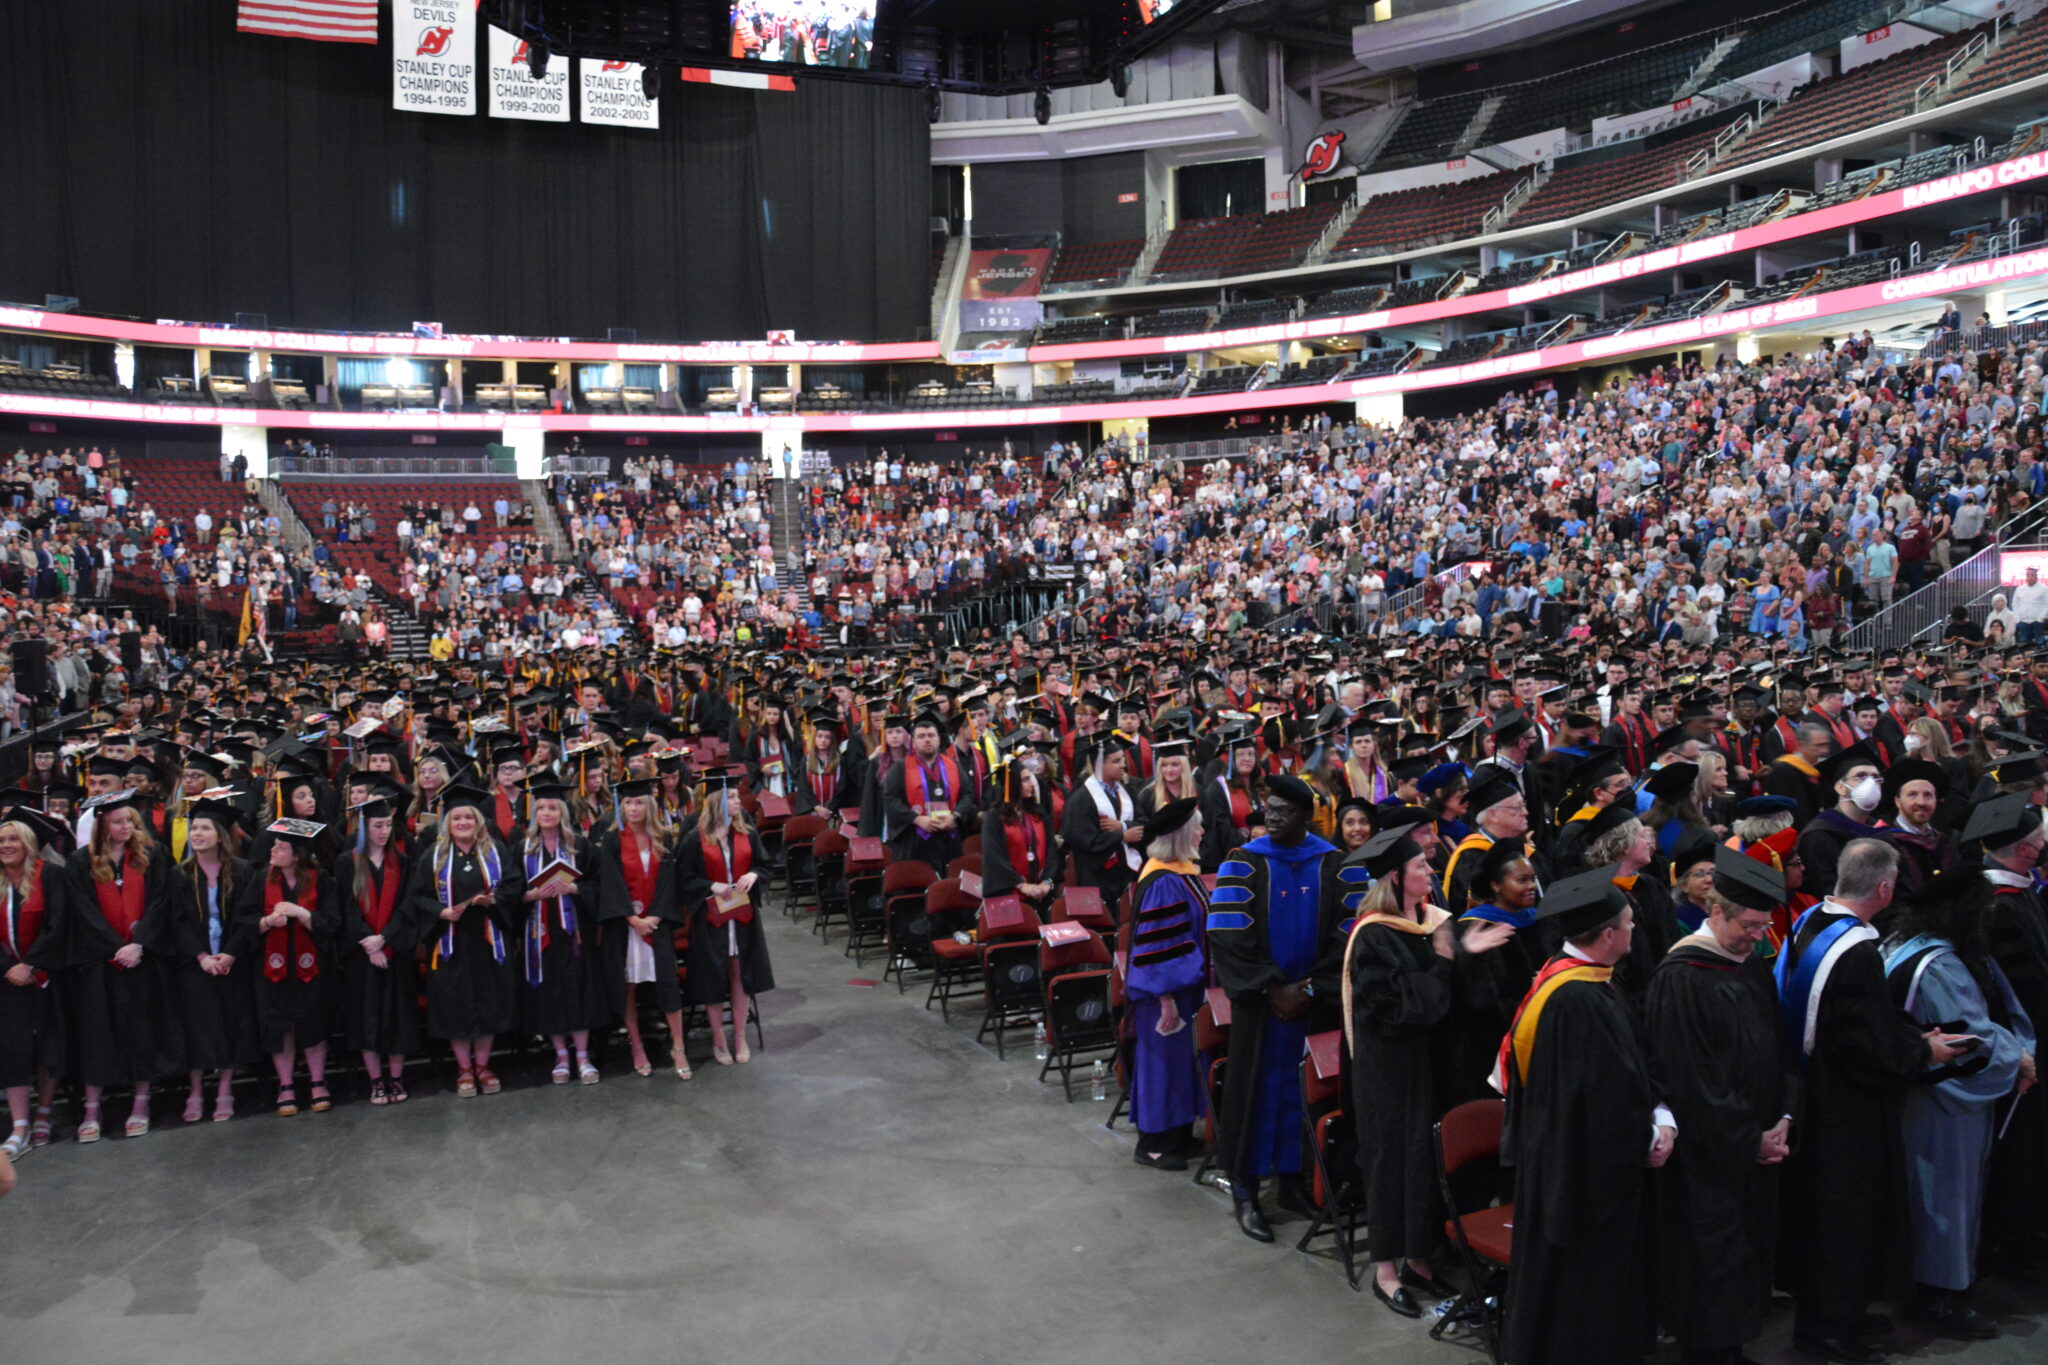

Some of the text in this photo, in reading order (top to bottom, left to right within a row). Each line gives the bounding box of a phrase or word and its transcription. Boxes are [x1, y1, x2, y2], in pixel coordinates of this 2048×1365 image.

[414, 8, 456, 23] DEVILS
[396, 59, 472, 78] STANLEY CUP
[493, 67, 567, 86] STANLE CUP
[400, 76, 469, 94] CHAMPIONS
[585, 74, 630, 91] STANLEY
[403, 93, 467, 107] 1994-1995
[496, 83, 563, 101] CHAMPIONS
[500, 101, 560, 114] 1999-2000
[590, 106, 649, 121] 2002-2003
[1903, 168, 1993, 207] RAMAPO
[976, 271, 1037, 279] JERSEY
[1622, 258, 1642, 276] OF
[979, 317, 1021, 327] 1982
[1750, 306, 1773, 324] OF
